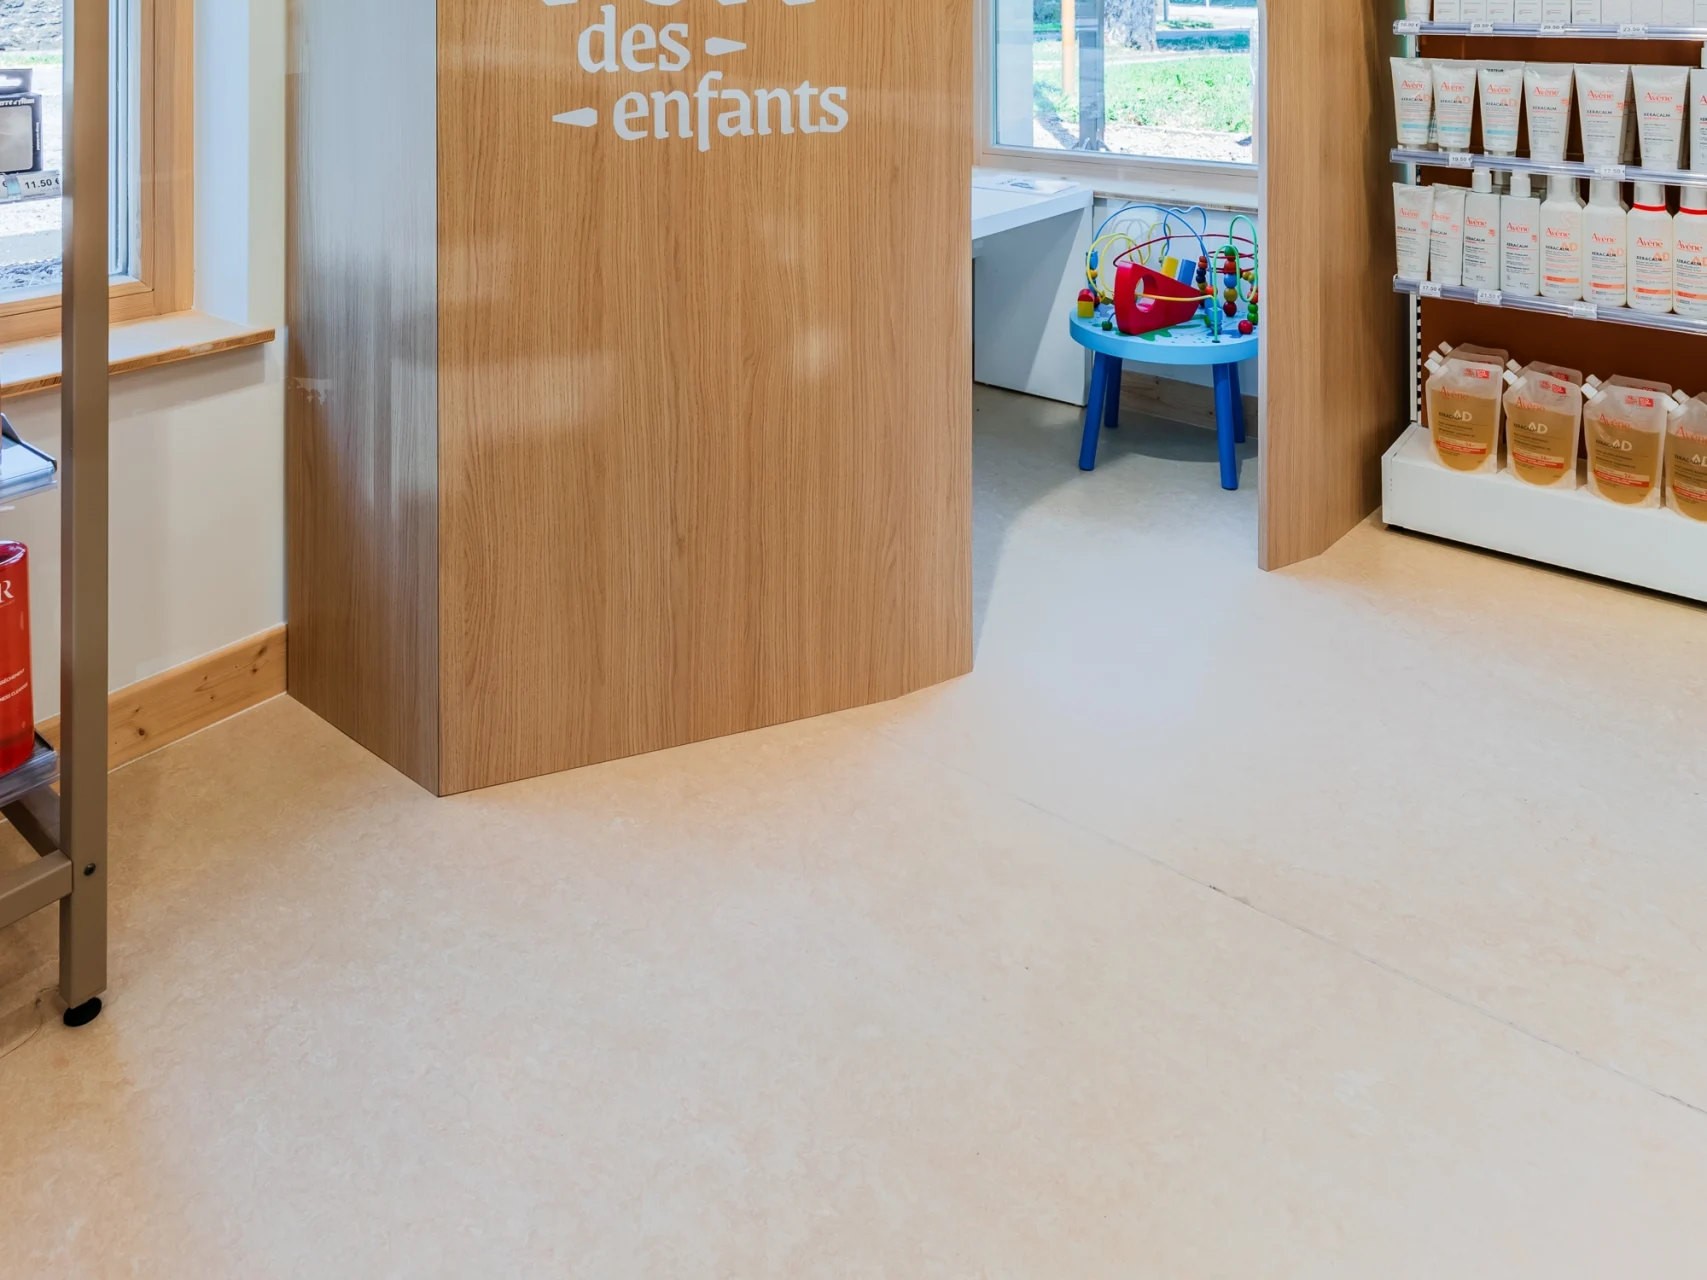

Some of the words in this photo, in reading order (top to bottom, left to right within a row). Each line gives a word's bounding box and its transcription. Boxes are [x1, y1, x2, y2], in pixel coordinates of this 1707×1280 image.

[577, 4, 692, 74] des
[1441, 81, 1465, 92] Avène
[1486, 84, 1511, 94] Avène
[1533, 86, 1559, 97] Avène
[1587, 90, 1614, 100] Avène
[1644, 92, 1673, 102] Avène
[613, 71, 849, 152] enfants
[25, 178, 52, 190] 11.50
[1465, 216, 1487, 227] Avène
[1507, 222, 1529, 233] Avène
[1546, 227, 1571, 237] Avène
[1591, 232, 1617, 243] Avène
[1636, 237, 1663, 248] Avène
[1677, 239, 1703, 251] Avène
[1441, 385, 1468, 400] Avène
[1516, 396, 1546, 412] Avène
[1600, 413, 1631, 429] Avène
